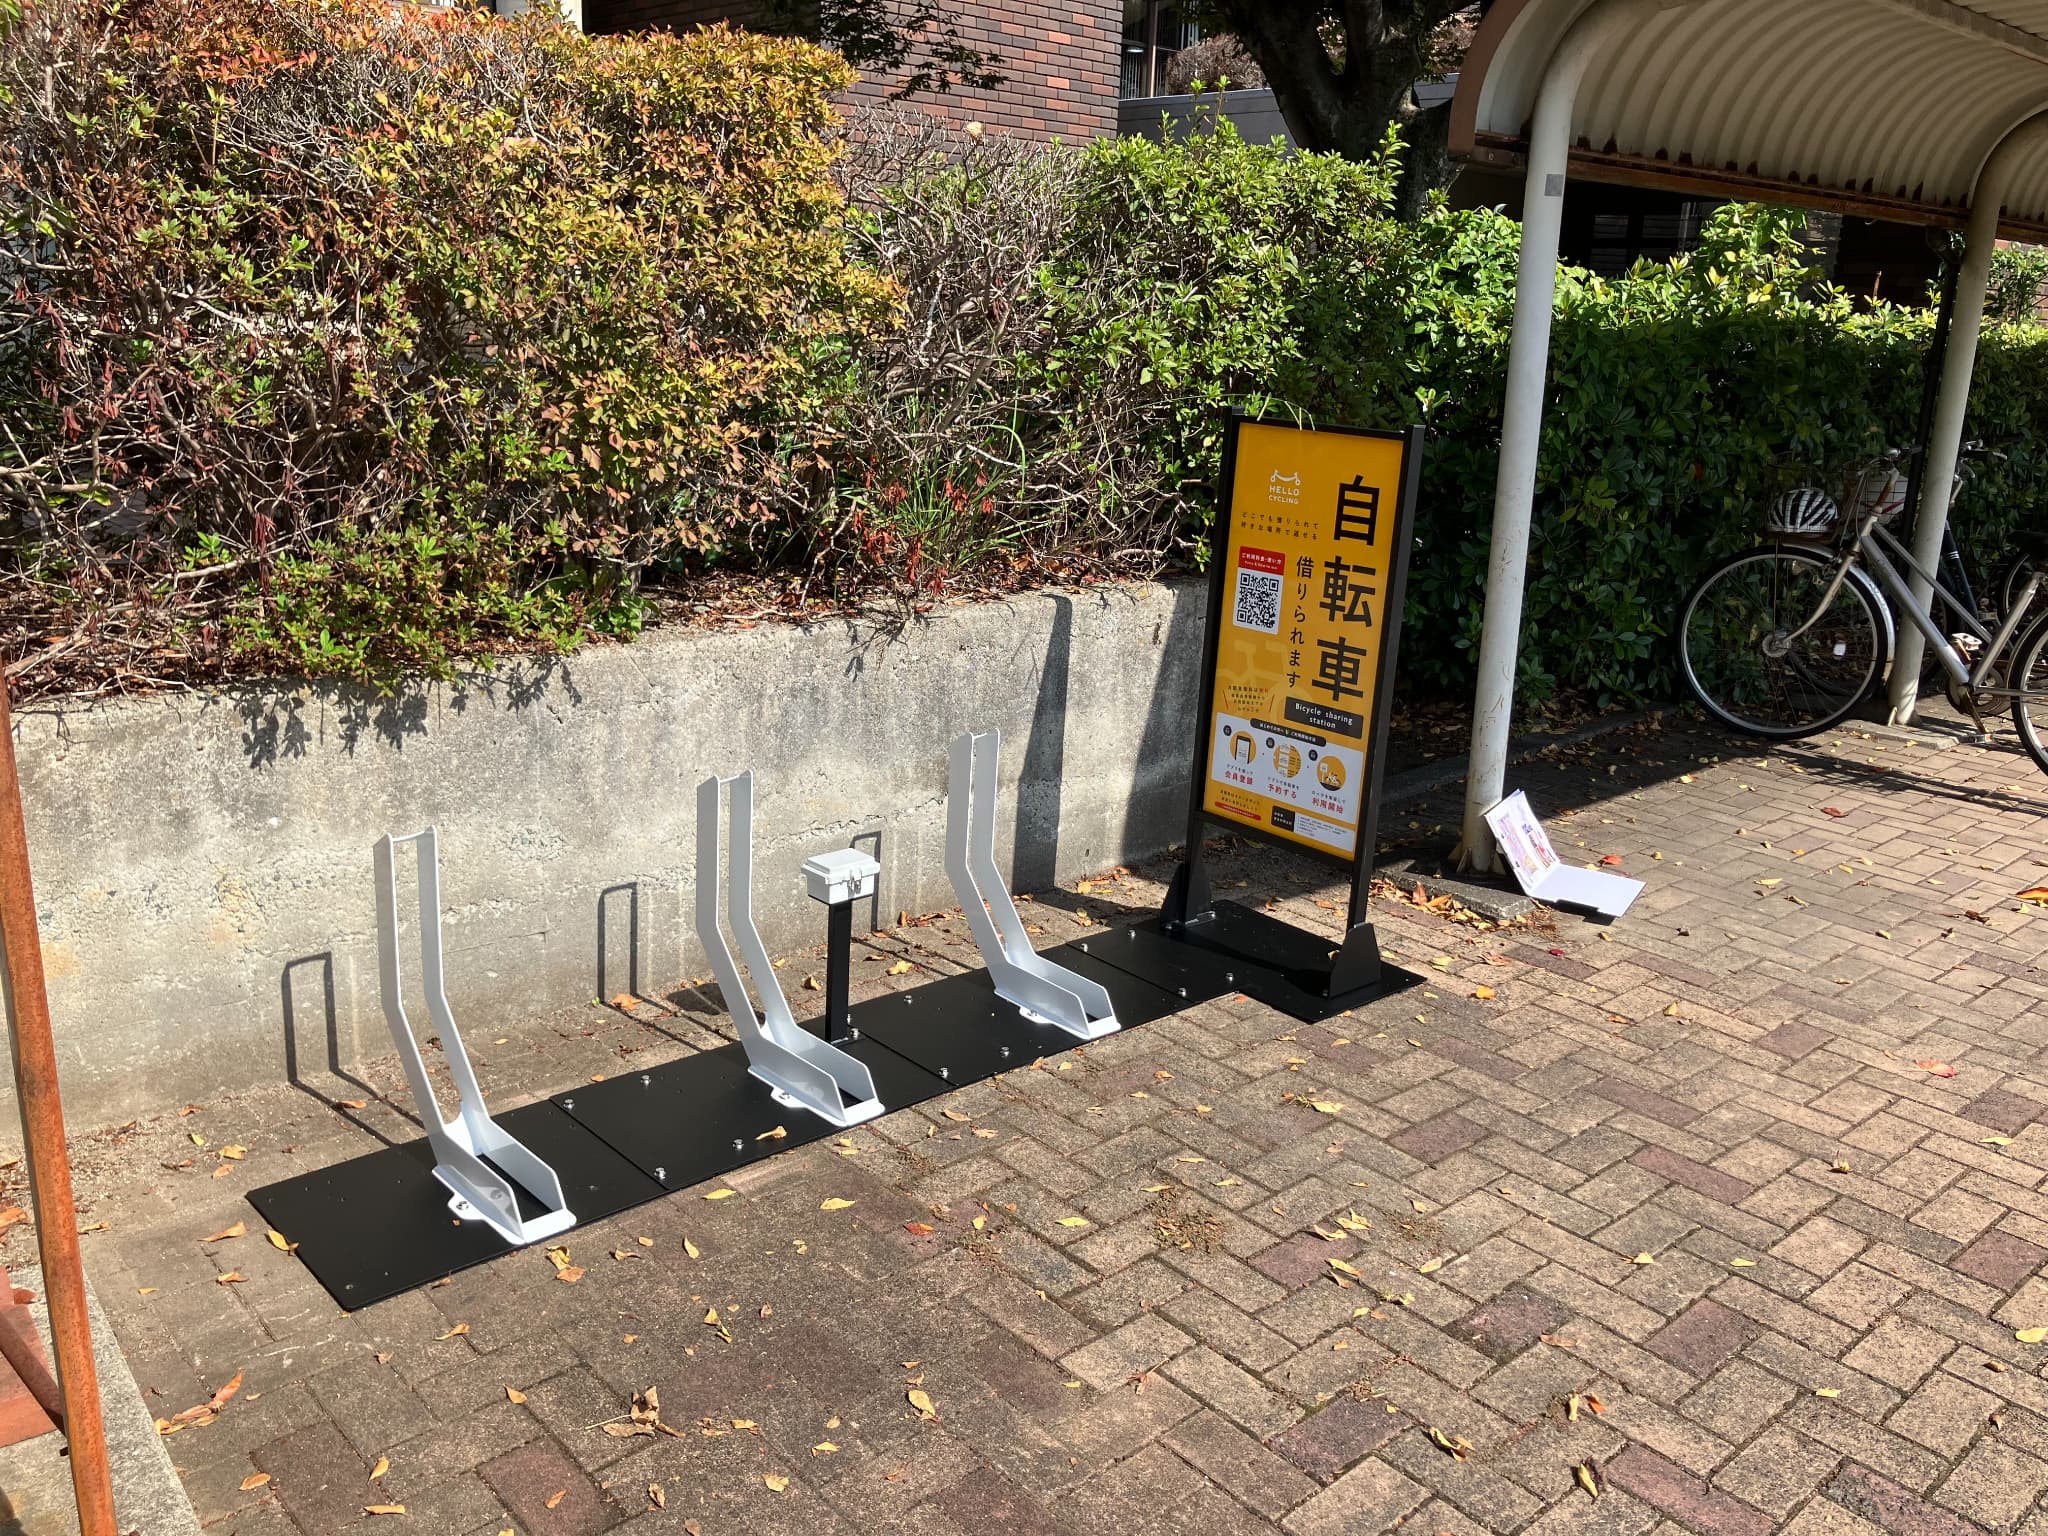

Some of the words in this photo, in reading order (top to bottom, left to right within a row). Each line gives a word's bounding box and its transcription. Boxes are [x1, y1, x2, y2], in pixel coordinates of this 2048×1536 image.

[1269, 484, 1300, 496] HELLO
[1268, 495, 1299, 505] CYCLING
[1312, 473, 1380, 702] 自転車
[1286, 555, 1315, 689] 借りられます
[1295, 702, 1321, 716] Bicycle
[1325, 711, 1353, 726] sharing
[1309, 717, 1336, 729] station
[1267, 783, 1297, 799] 予約する
[1311, 797, 1344, 814] 利用開始
